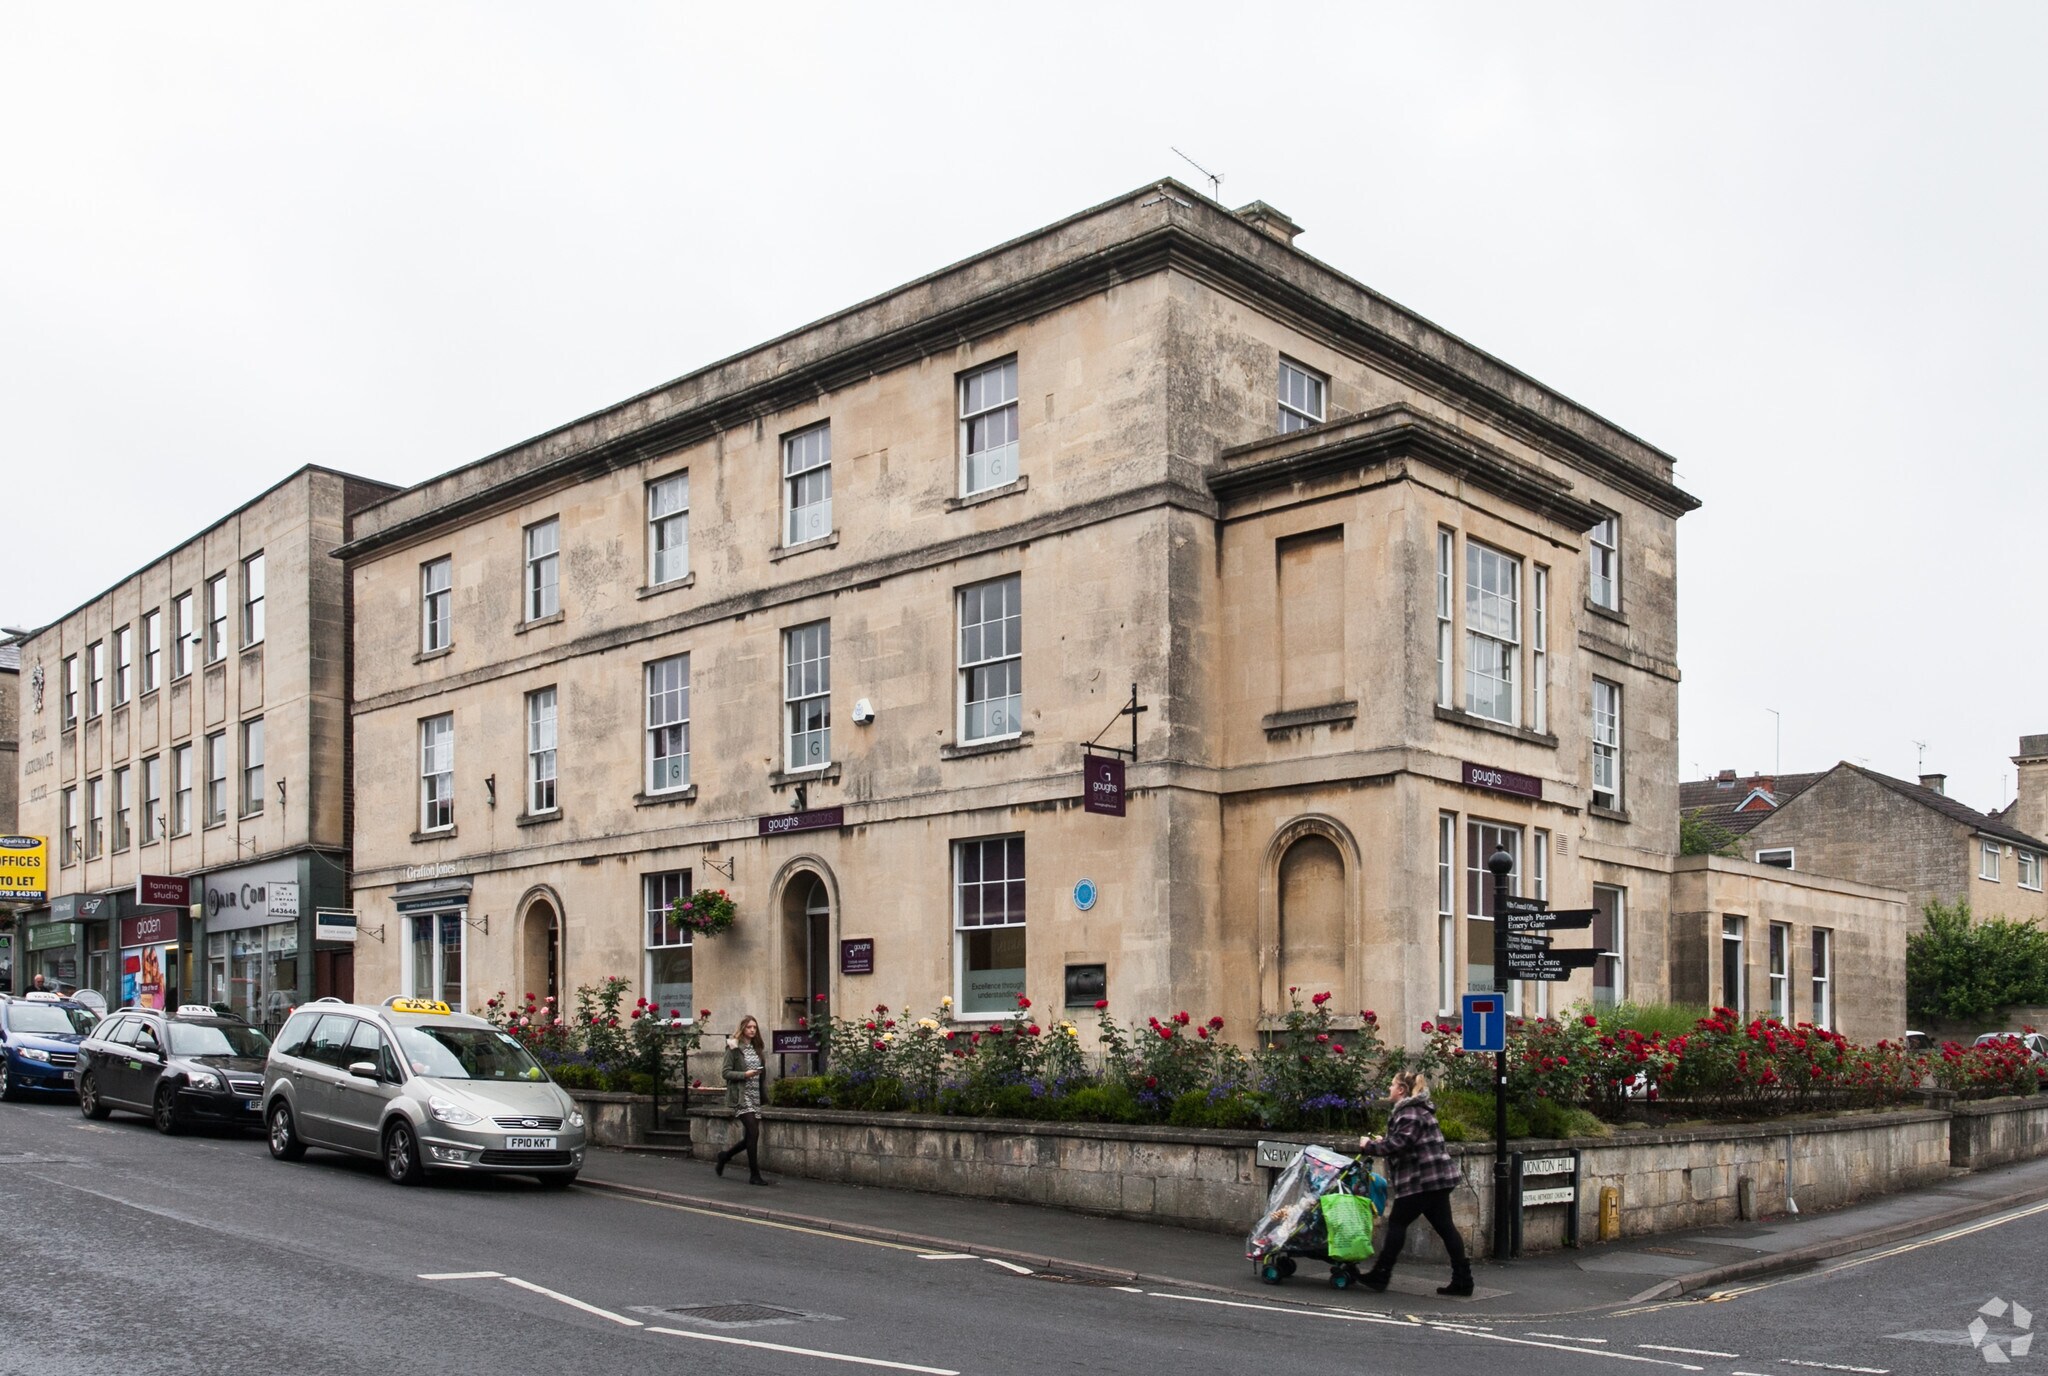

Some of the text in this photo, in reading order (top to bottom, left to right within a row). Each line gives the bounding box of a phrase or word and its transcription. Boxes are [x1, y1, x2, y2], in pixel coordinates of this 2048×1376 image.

[992, 709, 1002, 726] G
[810, 740, 820, 756] G
[671, 764, 680, 778] G
[1472, 768, 1502, 786] goughs
[1092, 782, 1118, 794] goughs
[768, 816, 798, 832] goughs
[0, 856, 40, 866] FFICES
[407, 862, 456, 878] Grafton Jones
[0, 876, 34, 886] TO LET
[150, 882, 182, 892] tanning
[154, 892, 180, 900] studio
[1508, 922, 1528, 930] Emery
[854, 944, 870, 952] goughs
[1520, 971, 1538, 979] History
[972, 981, 1024, 990] Excellence through
[401, 1002, 446, 1011] TAXI
[784, 1035, 802, 1044] goughs
[512, 1138, 551, 1148] FP10 KKT
[1262, 1148, 1290, 1162] NEW
[1524, 1159, 1572, 1174] MONKTON HILL
[1609, 1196, 1618, 1216] H
